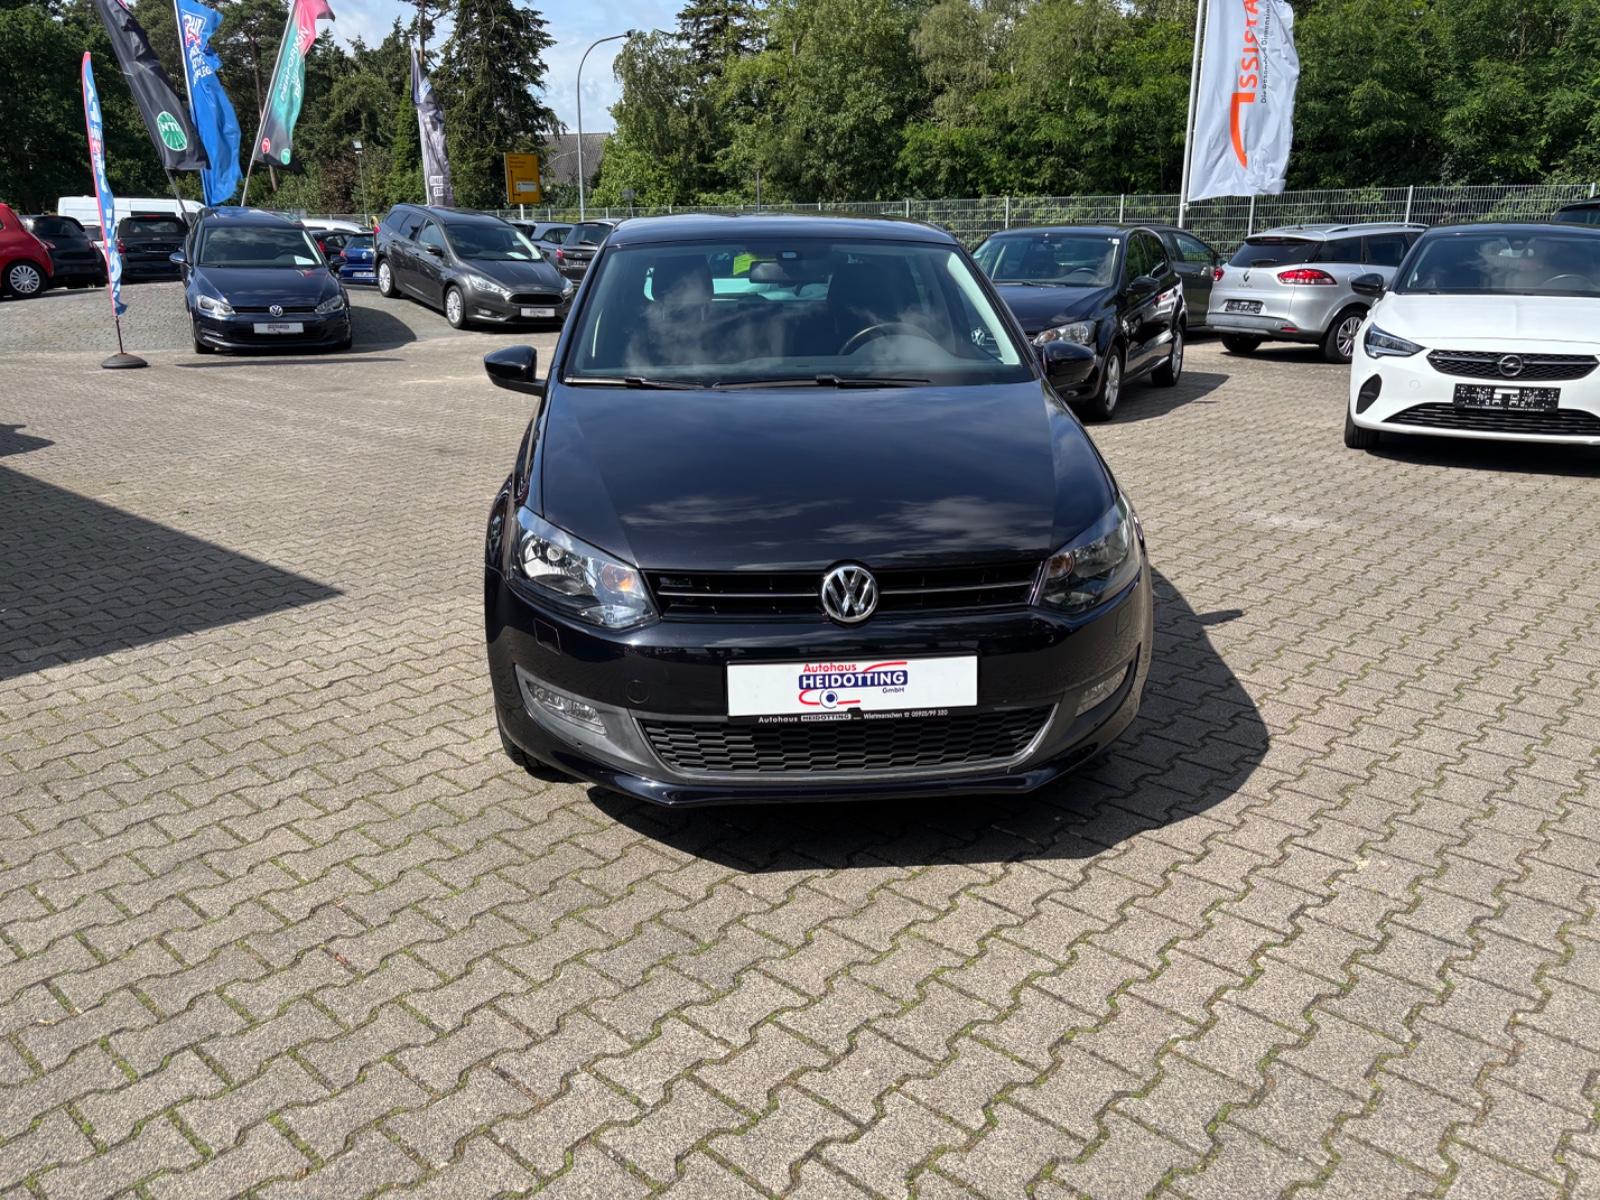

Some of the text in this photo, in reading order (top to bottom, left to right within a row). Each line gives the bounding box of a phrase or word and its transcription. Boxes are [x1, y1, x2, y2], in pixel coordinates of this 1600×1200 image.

[803, 663, 857, 673] Autohaus
[801, 672, 905, 687] HEIDOTTING
[758, 716, 798, 724] Autohaus
